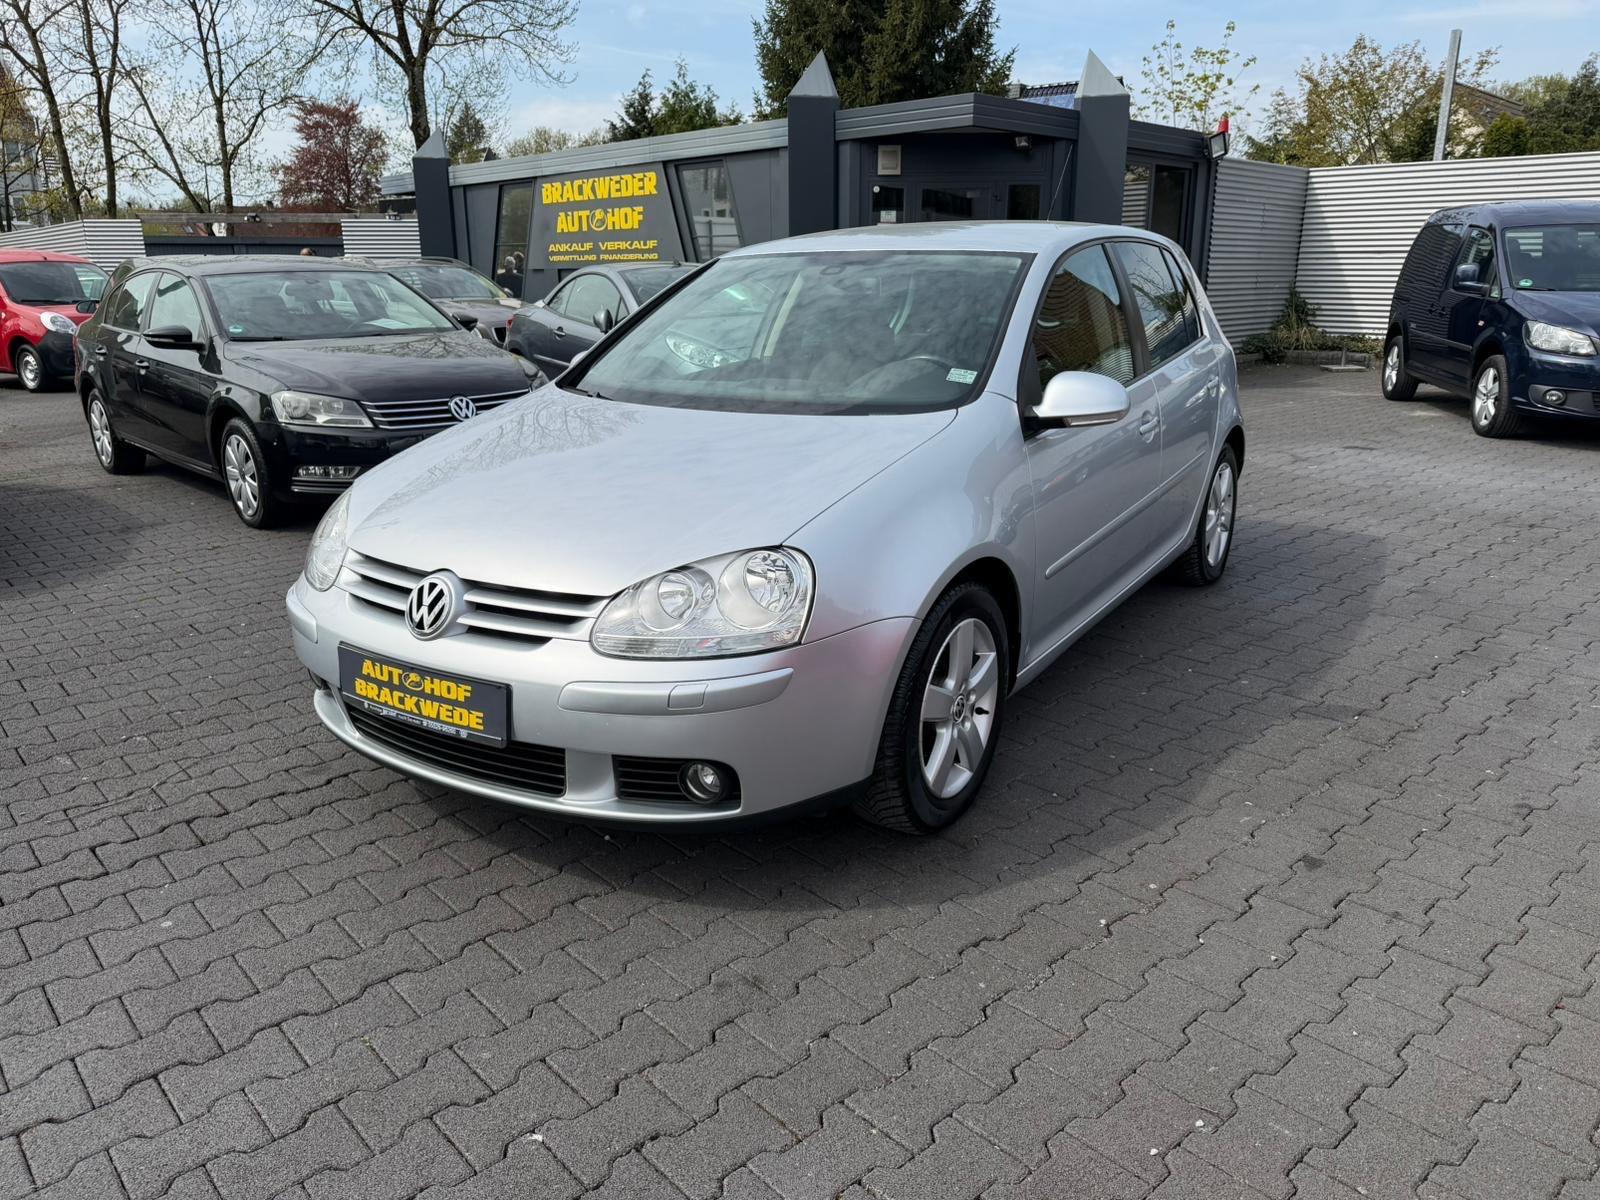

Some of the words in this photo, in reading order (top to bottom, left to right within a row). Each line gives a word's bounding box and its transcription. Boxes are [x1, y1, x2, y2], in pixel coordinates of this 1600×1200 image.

[542, 171, 658, 204] BRACKWEDER
[548, 242, 593, 252] ANKAUF
[599, 240, 658, 250] VERKAUF
[548, 253, 597, 261] VERMITTLUNG
[600, 253, 658, 261] FINANZIERUNG
[451, 397, 476, 420] VW
[408, 577, 452, 637] VW
[354, 677, 484, 730] BRACKWEDE
